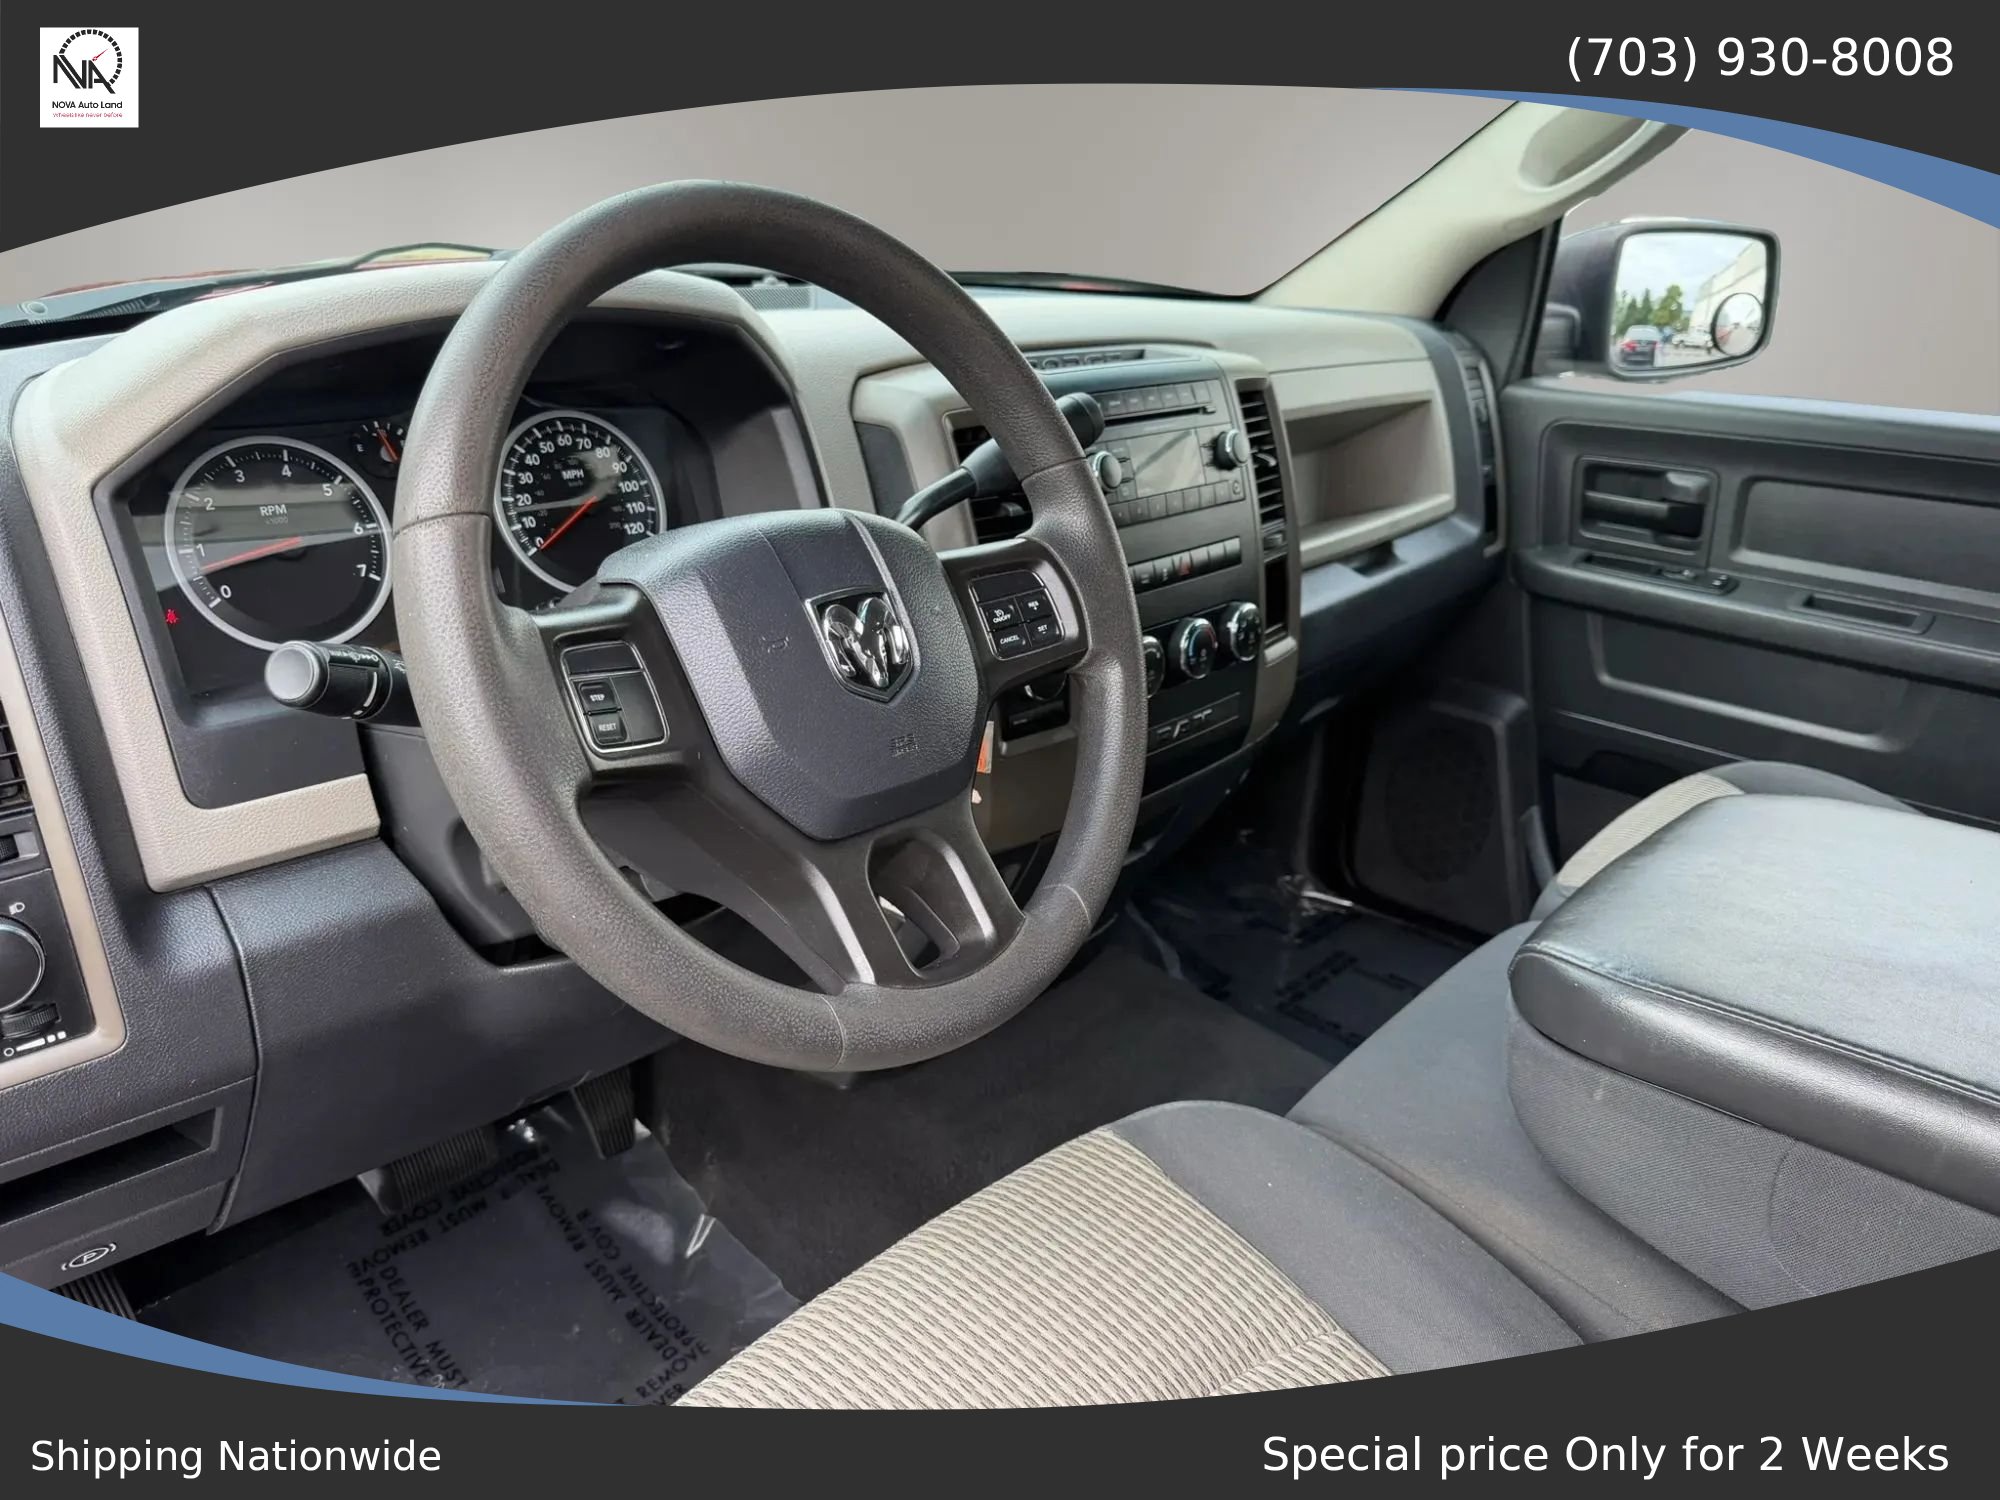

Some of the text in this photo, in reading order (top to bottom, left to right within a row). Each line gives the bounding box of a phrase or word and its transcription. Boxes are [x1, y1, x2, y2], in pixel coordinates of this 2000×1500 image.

[557, 434, 573, 447] 60
[575, 438, 592, 450] 70
[539, 441, 555, 454] 50
[595, 447, 611, 459] 80
[524, 453, 540, 467] 40
[281, 465, 292, 478] 4
[561, 468, 584, 481] MPH
[612, 462, 628, 474] 90
[234, 470, 246, 483] 3
[517, 471, 534, 485] 30
[322, 483, 333, 497] 5
[618, 481, 640, 494] 100
[204, 497, 216, 511] 2
[516, 493, 533, 506] 20
[259, 504, 288, 517] RPM
[626, 501, 646, 515] 110
[353, 520, 364, 535] 6
[522, 515, 537, 528] 10
[623, 521, 645, 536] 120
[196, 543, 206, 557] 1
[356, 564, 368, 578] 7
[219, 584, 232, 599] 0
[1000, 634, 1020, 645] CANCEL
[598, 722, 617, 731] RESET
[357, 1277, 434, 1384] PROTECTIVE
[379, 1265, 469, 1388] DEALER MUST
